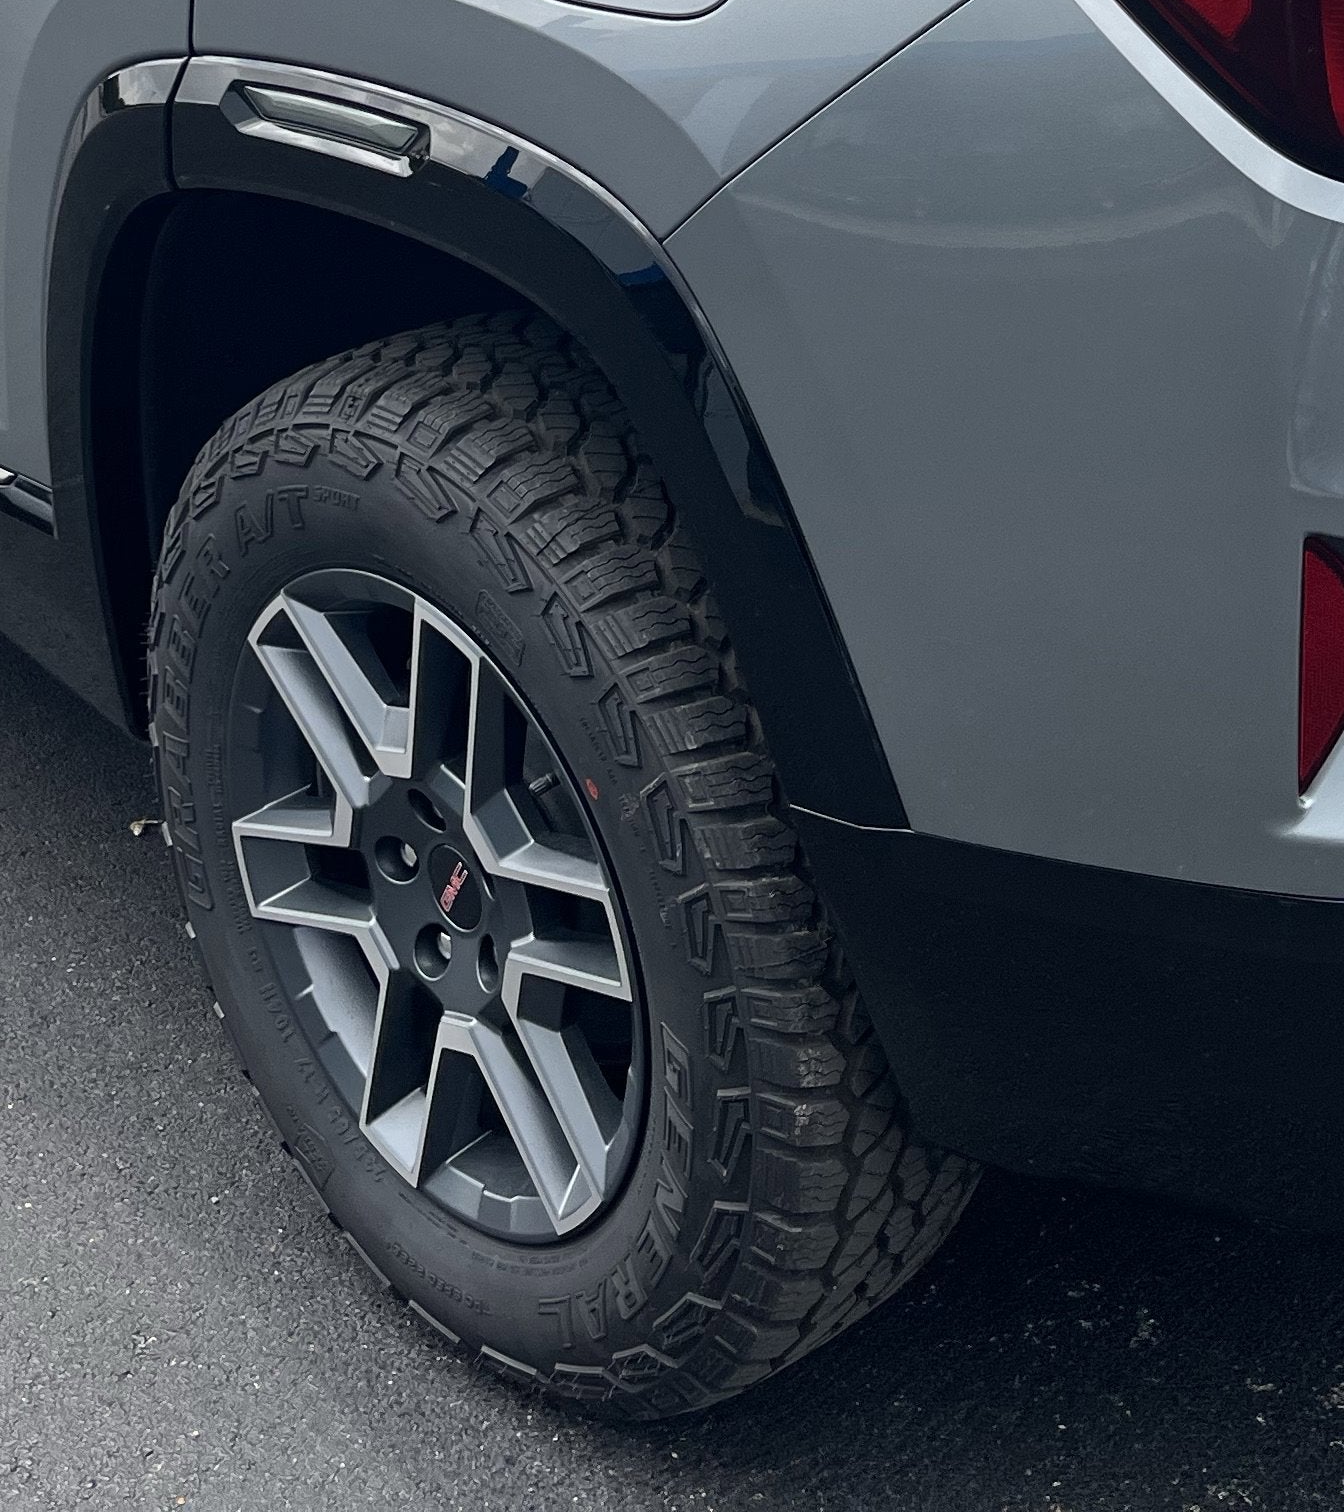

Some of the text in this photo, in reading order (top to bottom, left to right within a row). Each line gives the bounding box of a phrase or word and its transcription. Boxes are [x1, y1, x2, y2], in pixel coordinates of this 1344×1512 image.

[162, 533, 231, 912] GRABBER
[234, 484, 309, 558] A/T
[439, 861, 469, 913] GMC
[537, 1020, 696, 1349] GENERAL
